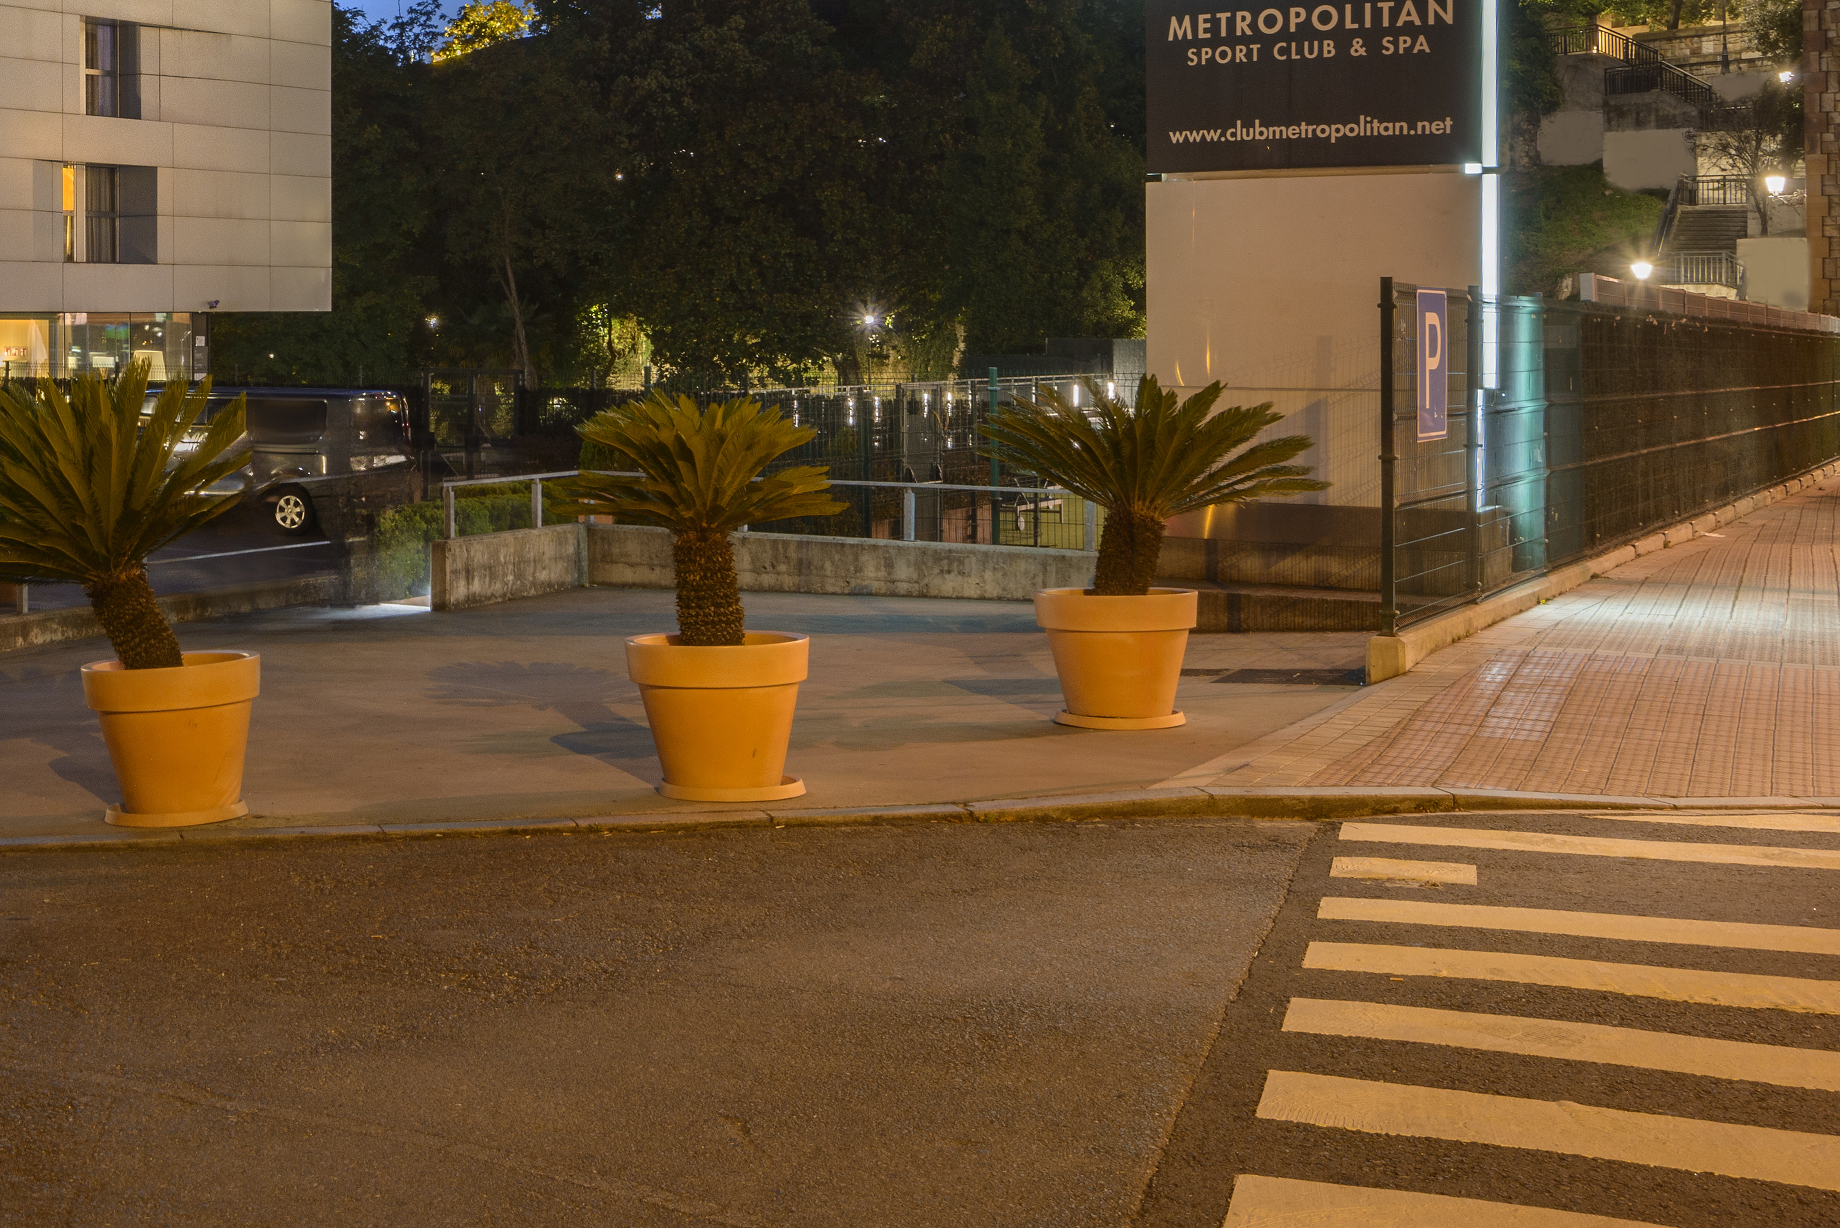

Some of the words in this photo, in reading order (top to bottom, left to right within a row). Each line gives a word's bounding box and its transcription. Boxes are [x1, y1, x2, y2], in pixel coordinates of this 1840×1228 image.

[1186, 43, 1261, 66] SPORT
[1273, 39, 1336, 61] CLUB
[1349, 37, 1368, 57] &
[1381, 34, 1431, 55] SPA
[1168, 114, 1453, 144] www.clubmetropolitan.net
[1425, 311, 1442, 409] P
